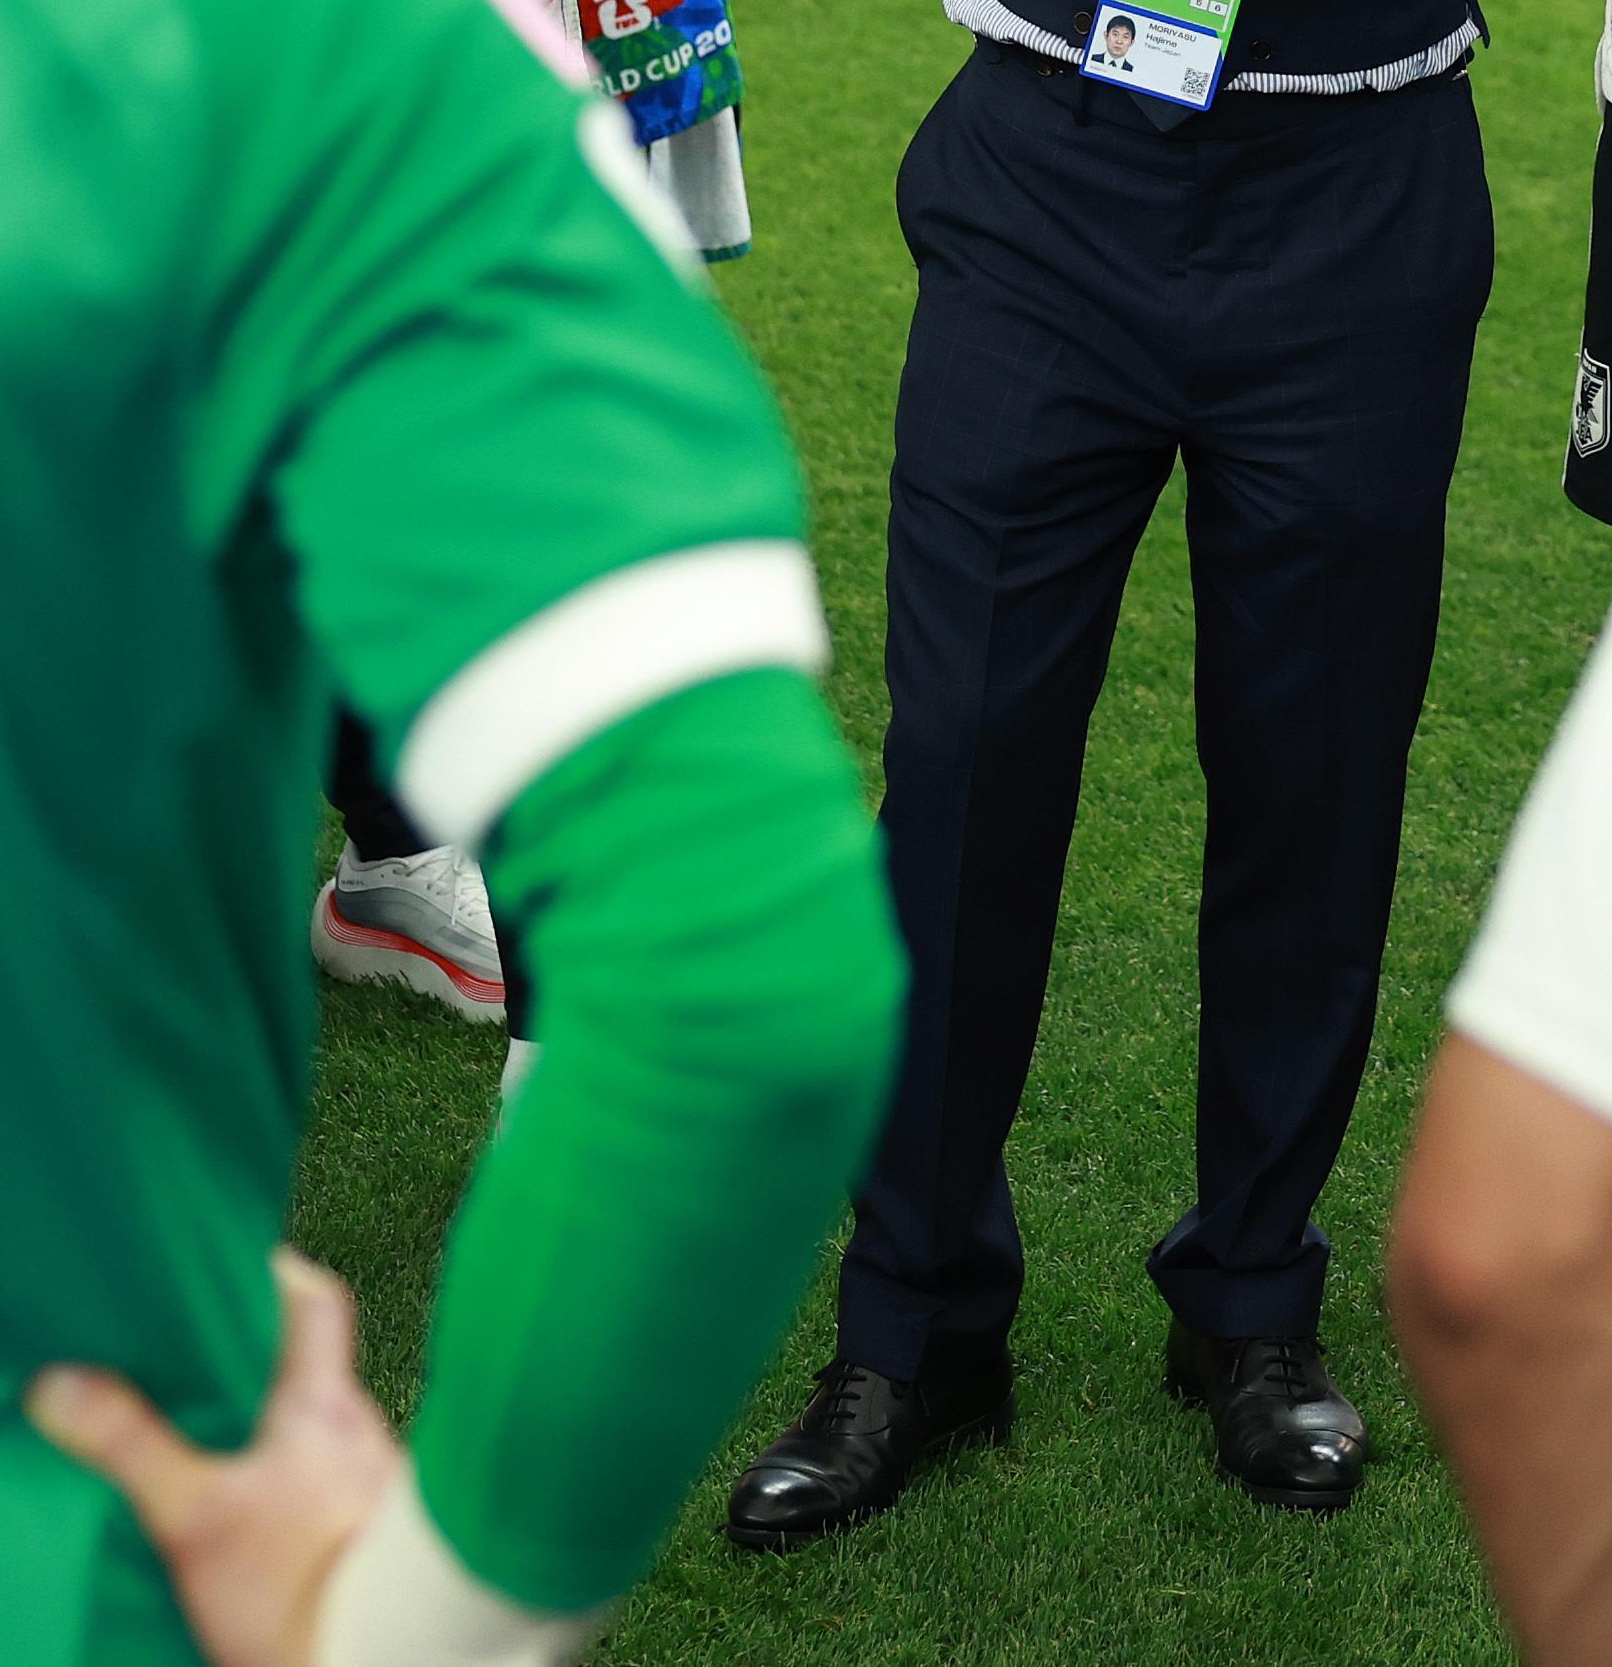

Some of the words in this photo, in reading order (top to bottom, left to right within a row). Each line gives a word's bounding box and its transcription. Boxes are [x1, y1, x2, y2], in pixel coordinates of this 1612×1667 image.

[646, 42, 694, 81] CUP
[695, 19, 732, 58] 20
[1148, 23, 1197, 42] MORIYASU
